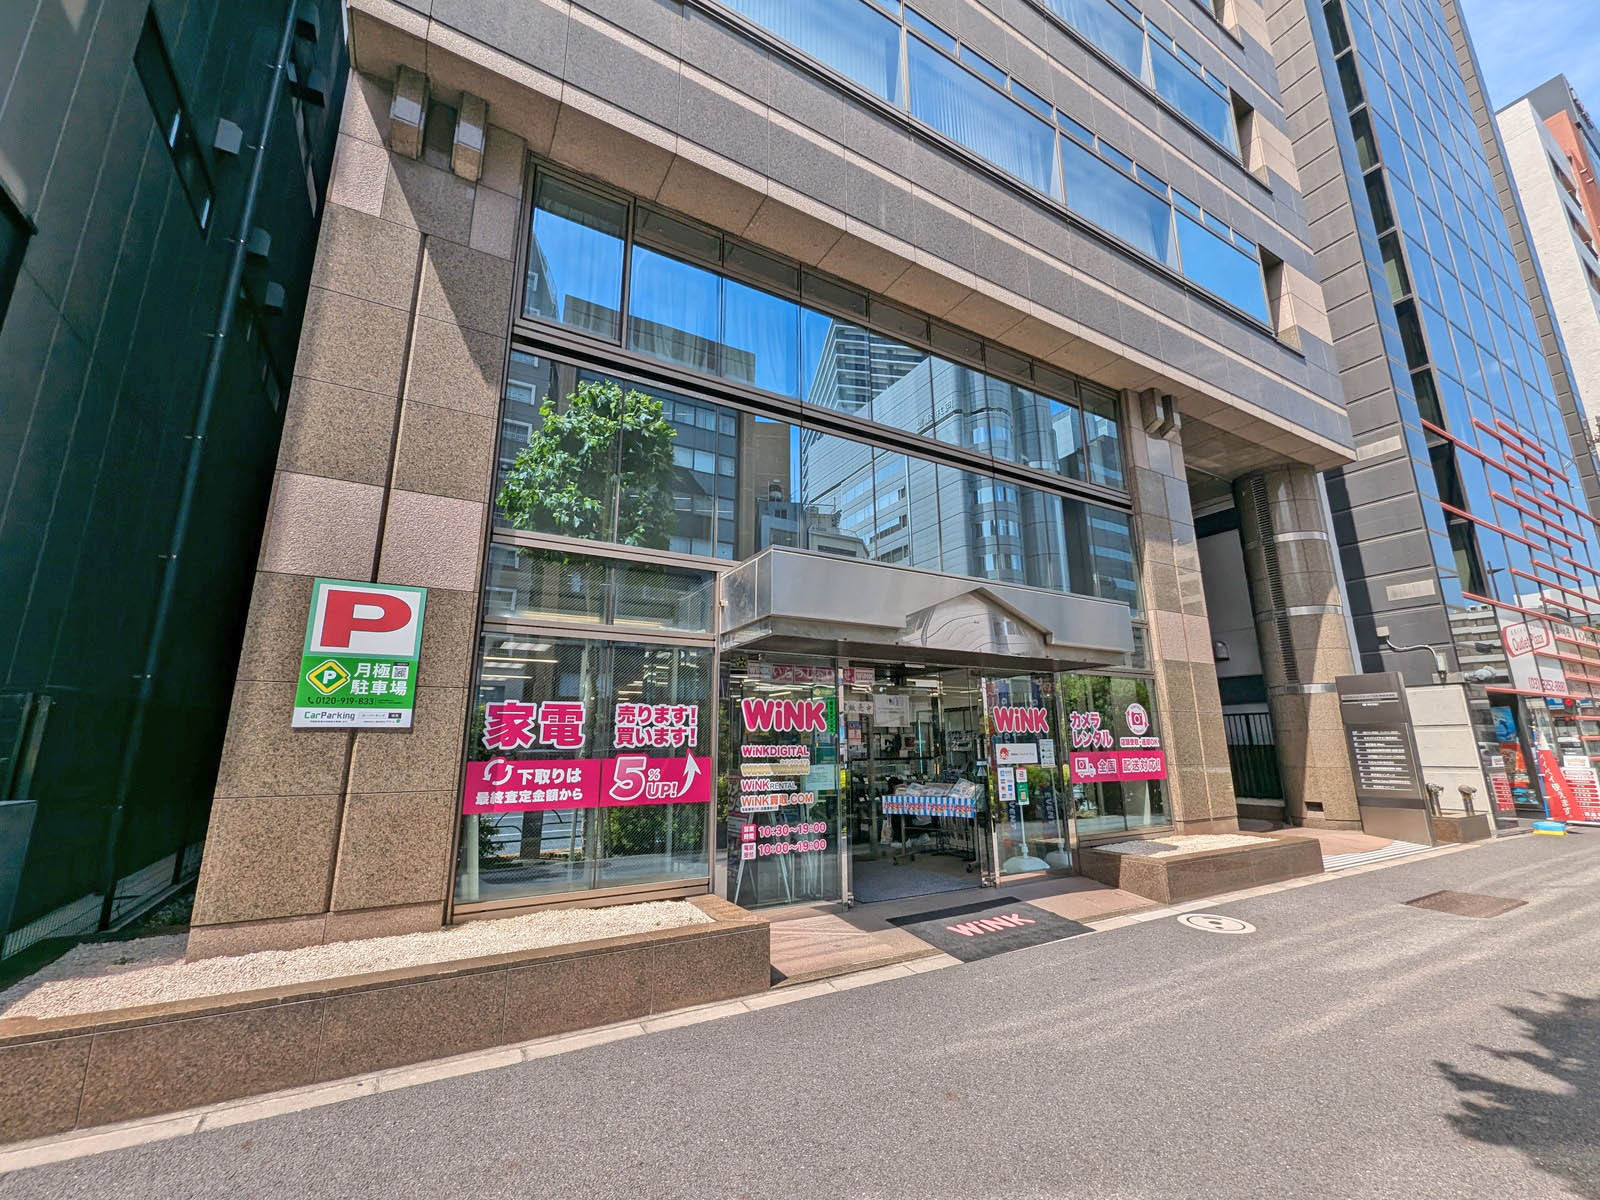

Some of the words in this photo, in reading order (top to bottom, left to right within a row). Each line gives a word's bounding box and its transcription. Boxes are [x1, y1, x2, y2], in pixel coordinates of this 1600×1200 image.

[320, 589, 412, 648] P
[322, 670, 337, 684] P
[354, 662, 391, 678] 月極
[350, 679, 408, 696] 駐車場
[483, 700, 584, 749] 家電
[1070, 711, 1101, 729] カメラ
[1072, 730, 1113, 748] レンタル
[517, 768, 582, 785] 下取りは
[475, 788, 583, 805] 最終査定金額から
